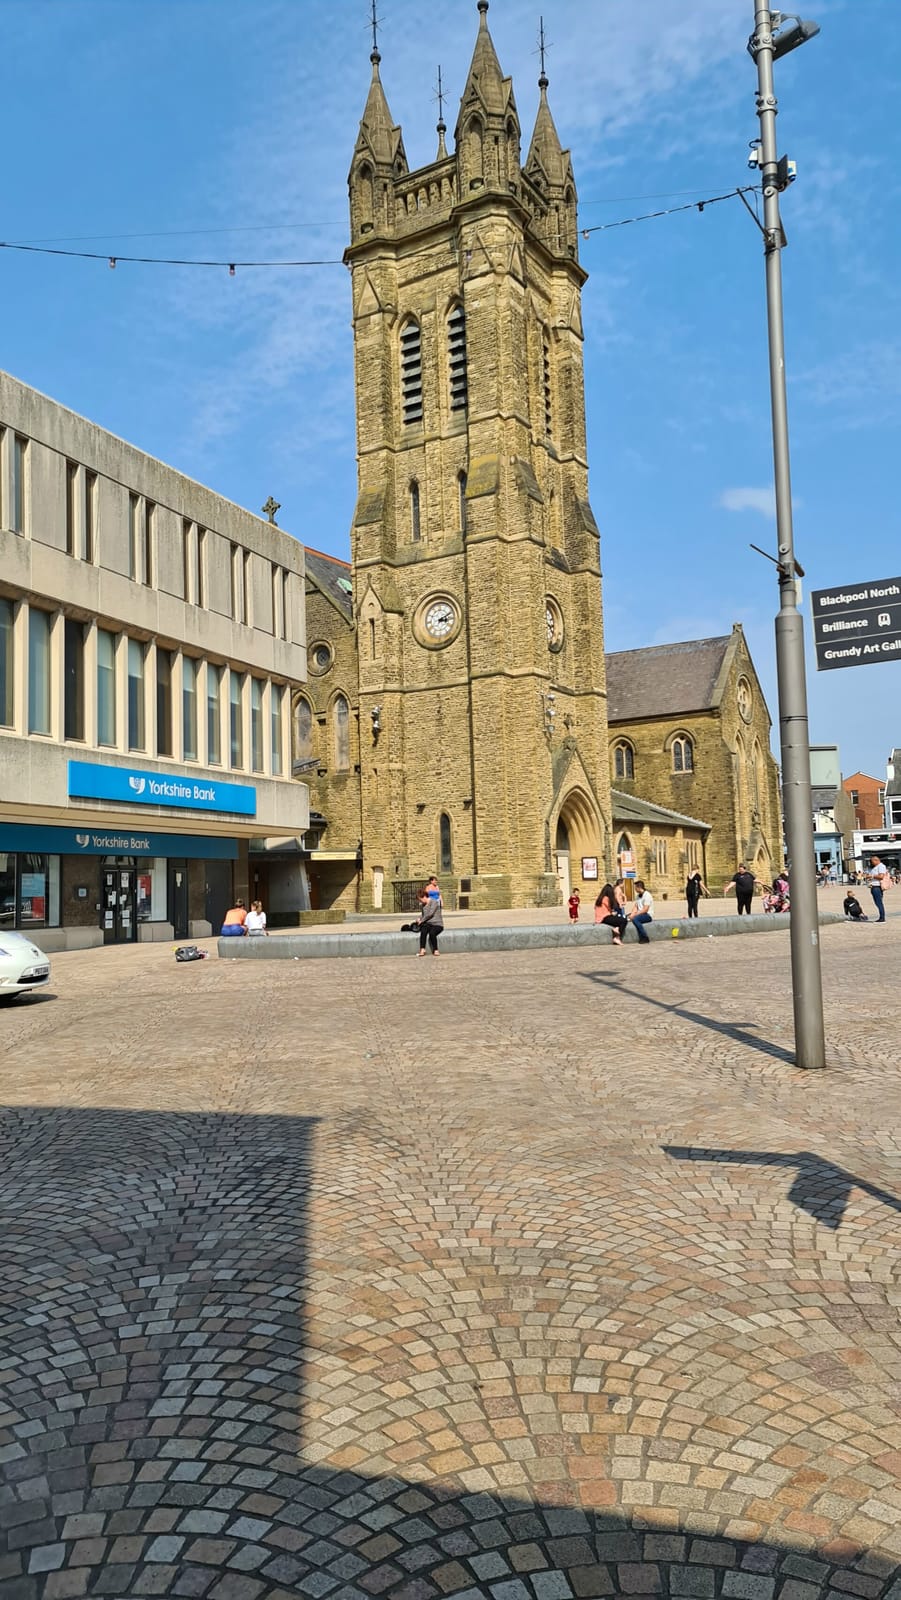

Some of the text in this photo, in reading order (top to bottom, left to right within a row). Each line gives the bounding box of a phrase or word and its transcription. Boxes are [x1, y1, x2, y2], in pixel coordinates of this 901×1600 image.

[820, 585, 900, 606] Blackpool North
[822, 619, 868, 632] Brilliance
[824, 647, 861, 659] Grundy
[863, 644, 880, 654] Art
[148, 779, 216, 801] Yorkshire Bank
[92, 835, 150, 850] Yorkshire Bank
